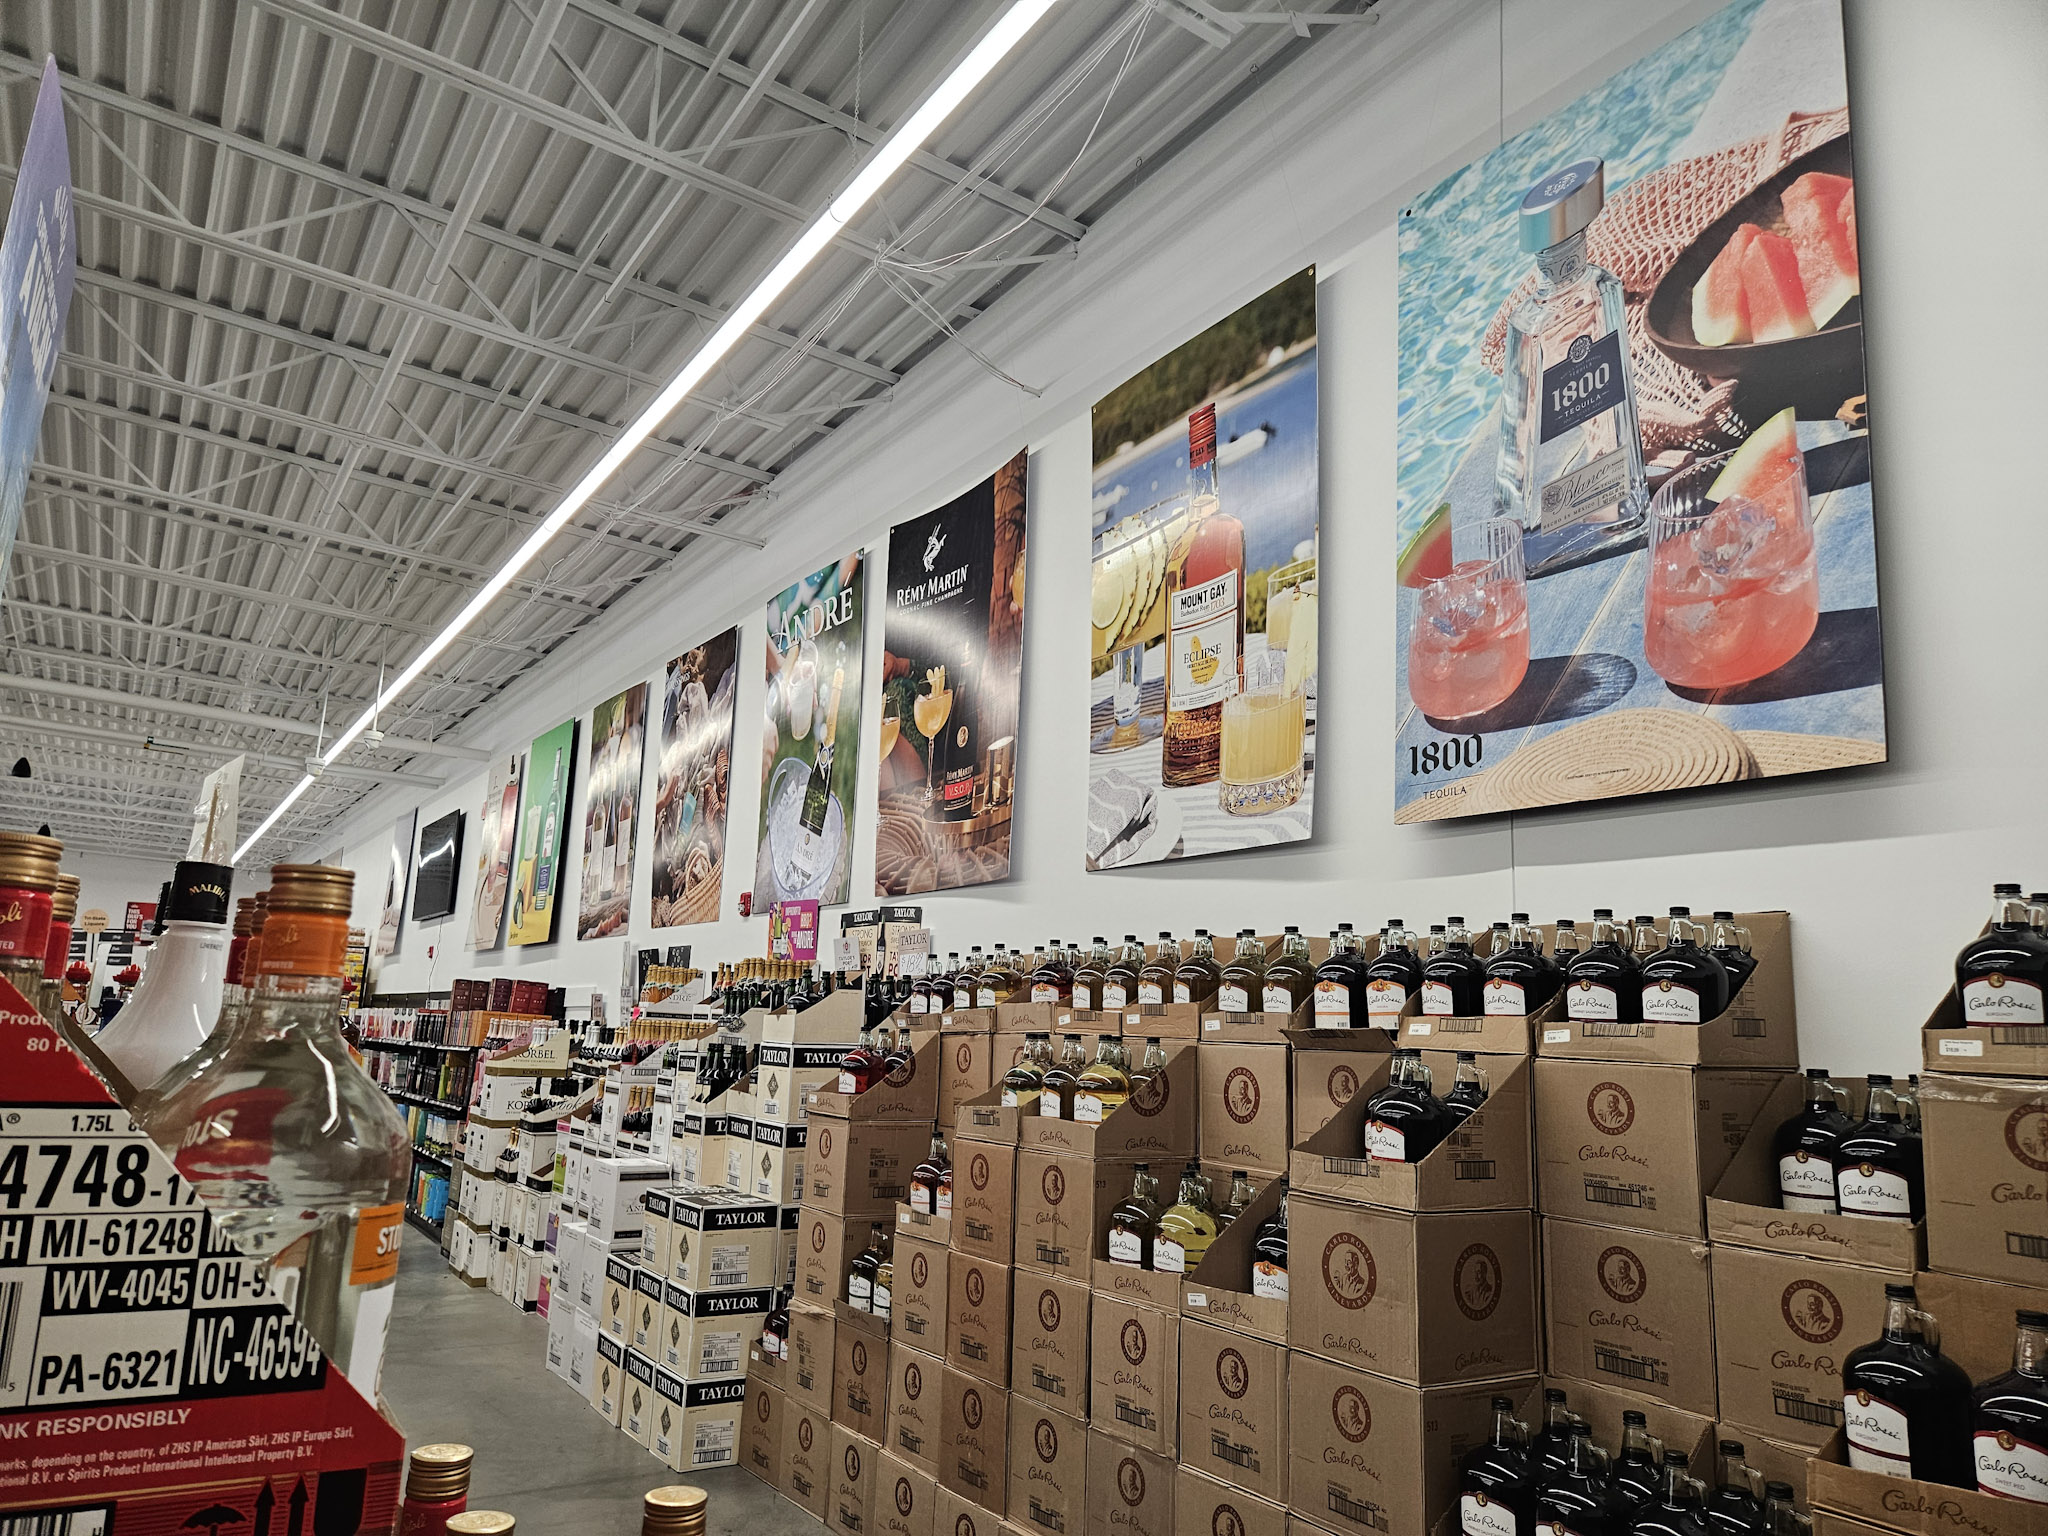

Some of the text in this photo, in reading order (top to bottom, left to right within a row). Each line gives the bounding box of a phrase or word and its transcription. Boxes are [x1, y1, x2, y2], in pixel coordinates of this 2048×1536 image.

[1551, 362, 1610, 412] 1800
[1564, 394, 1602, 417] TEQUILA
[1552, 463, 1610, 516] Blanco
[896, 563, 969, 608] RÉMY MARTIN
[1180, 582, 1226, 611] MOUNT GAY
[771, 570, 853, 655] ANDRÉ
[899, 586, 964, 616] COGNAC FINE CHAMPAGNE
[1210, 597, 1225, 612] 1703
[1183, 643, 1222, 664] ECLIPSE
[1408, 733, 1483, 777] 1800
[1422, 785, 1468, 800] TEQUILA
[854, 911, 874, 922] TAYLOR
[893, 907, 916, 918] TAYLOR
[900, 932, 928, 946] TAYLOR
[1570, 997, 1612, 1010] Carlo Rossi
[1646, 998, 1694, 1012] Carlo Rossi
[1969, 995, 2037, 1011] Carlo Rossi
[27, 1037, 50, 1052] 80
[762, 1049, 788, 1065] TAYLOR
[71, 1115, 114, 1132] 1.75L
[730, 1120, 749, 1136] TAYLOR
[756, 1125, 781, 1145] TAYLOR
[1223, 1145, 1262, 1161] Carlo Rossi
[1578, 1144, 1649, 1169] Carlo Rossi
[1783, 1169, 1834, 1185] Carlo Rossi
[648, 1196, 667, 1213] TAYLOR
[1843, 1184, 1904, 1201] Carlo Rossi
[1991, 1182, 2043, 1204] Carlo
[675, 1205, 699, 1227] TAYLOR
[715, 1211, 766, 1226] TAYLOR
[39, 1216, 197, 1259] MI-61248
[1765, 1220, 1853, 1249] Carlo Rossi
[1324, 1232, 1375, 1264] CARLO ROSSI
[608, 1262, 628, 1284] TAYLOR
[51, 1267, 190, 1311] WV-4045
[639, 1274, 660, 1298] TAYLOR
[1326, 1282, 1373, 1309] VINEYARDS
[667, 1287, 688, 1313] TAYLOR
[707, 1296, 759, 1312] TAYLOR
[1588, 1309, 1662, 1341] Carlo Rossi
[600, 1337, 618, 1363] TAYLOR
[1322, 1333, 1378, 1361] Carlo Rossi
[629, 1357, 651, 1383] TAYLOR
[1771, 1350, 1812, 1370] Carlo
[36, 1349, 179, 1396] PA-6321
[657, 1375, 681, 1402] TAYLOR
[36, 1407, 192, 1438] RESPONSIBLY
[1209, 1403, 1257, 1434] Carlo Rossi
[1427, 1420, 1438, 1433] 513
[32, 1452, 82, 1470] depending
[84, 1453, 96, 1464] on
[99, 1449, 114, 1462] the
[159, 1444, 170, 1456] of
[171, 1440, 191, 1455] ZHS
[193, 1439, 204, 1453] IP
[205, 1436, 247, 1452] Americas
[271, 1432, 290, 1445] ZHS
[292, 1430, 302, 1443] IP
[303, 1429, 332, 1443] Europe
[32, 1471, 51, 1485] B.V.
[54, 1472, 65, 1482] or
[67, 1467, 101, 1484] Spirits
[103, 1463, 141, 1478] Product
[143, 1455, 202, 1474] International
[204, 1450, 255, 1468] Intellectual
[257, 1447, 295, 1463] Property
[297, 1445, 315, 1458] B.V.
[1323, 1446, 1382, 1483] Carlo Rossi
[1463, 1509, 1511, 1534] Carlo Rossi
[1882, 1489, 1999, 1536] Carlo Rossi
